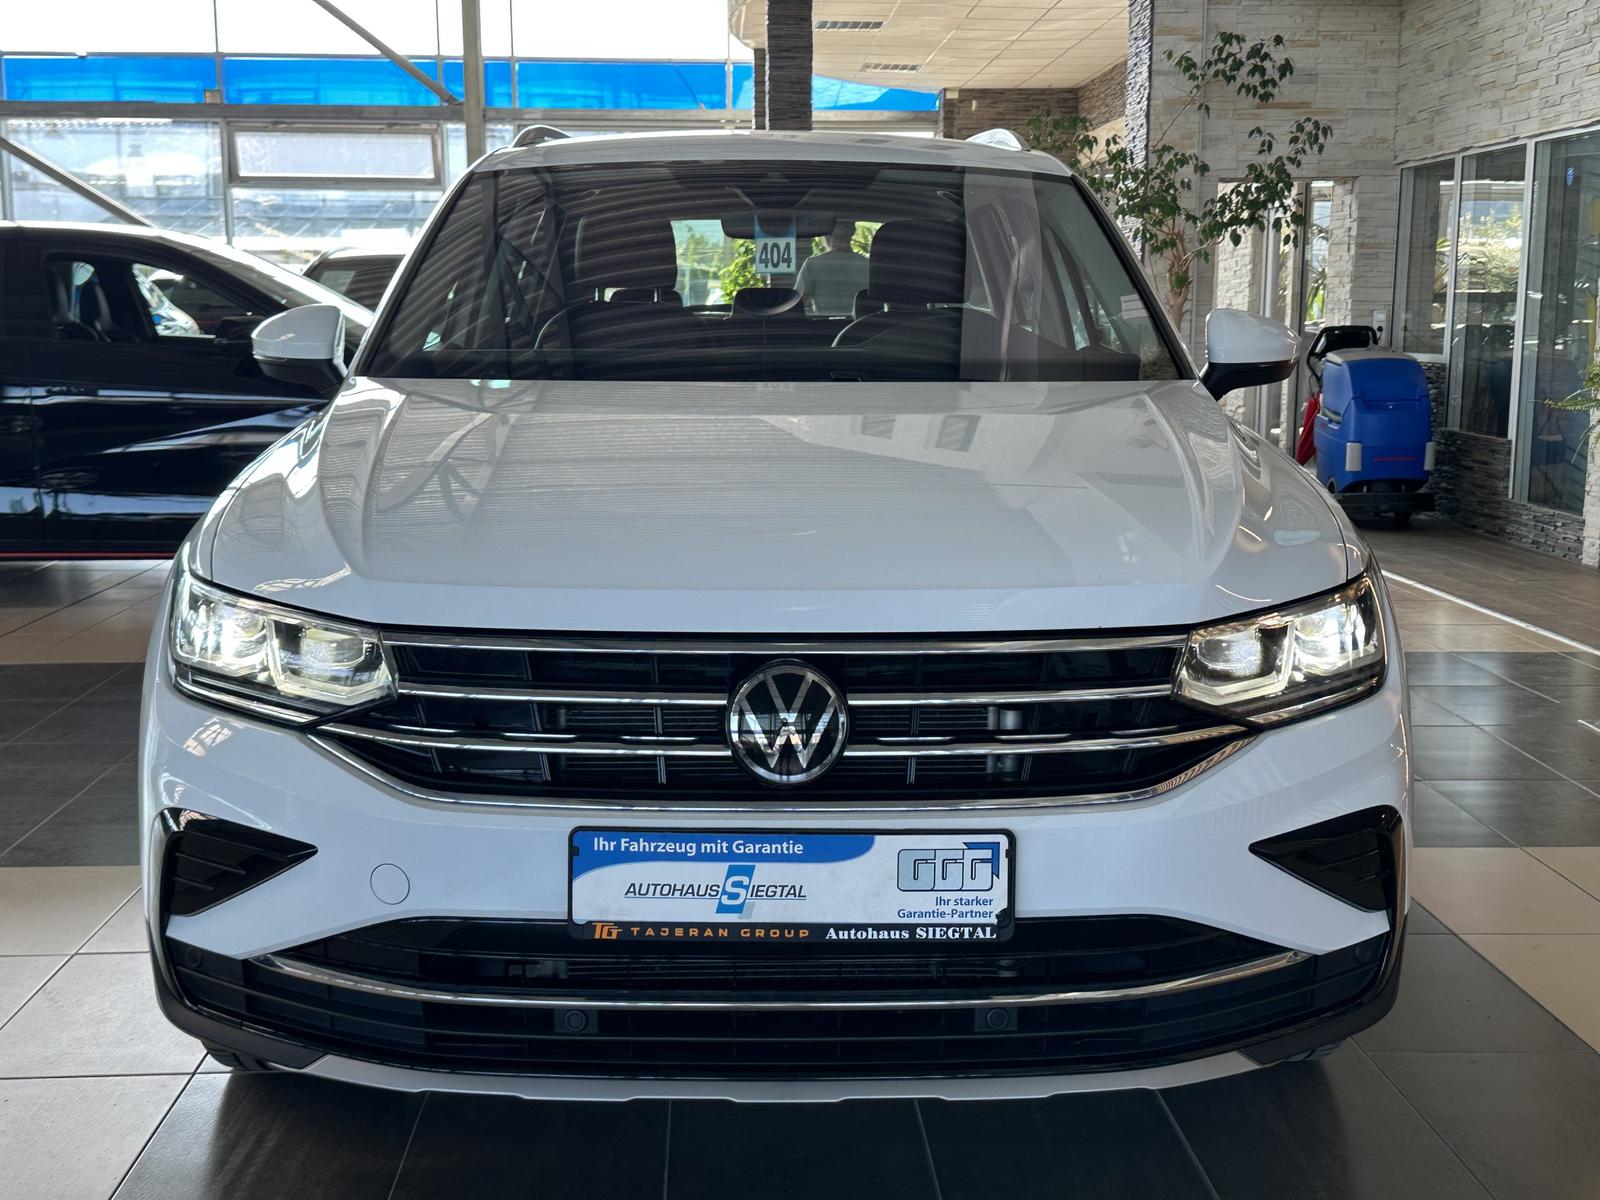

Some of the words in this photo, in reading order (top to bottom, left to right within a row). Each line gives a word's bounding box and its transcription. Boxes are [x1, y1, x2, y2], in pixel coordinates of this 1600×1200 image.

[758, 241, 793, 269] 404
[735, 670, 841, 771] VW
[593, 837, 616, 851] Ihr
[621, 838, 696, 856] Fahrzeug
[701, 840, 728, 853] mit
[732, 840, 804, 854] Garantie
[935, 896, 951, 906] Ihr
[953, 896, 994, 906] starker
[897, 908, 994, 919] Garantie-Partner
[630, 927, 728, 937] TAJERAN
[740, 928, 810, 938] GROUP
[825, 927, 910, 940] Autohaus
[915, 926, 997, 939] SIEGTAL
